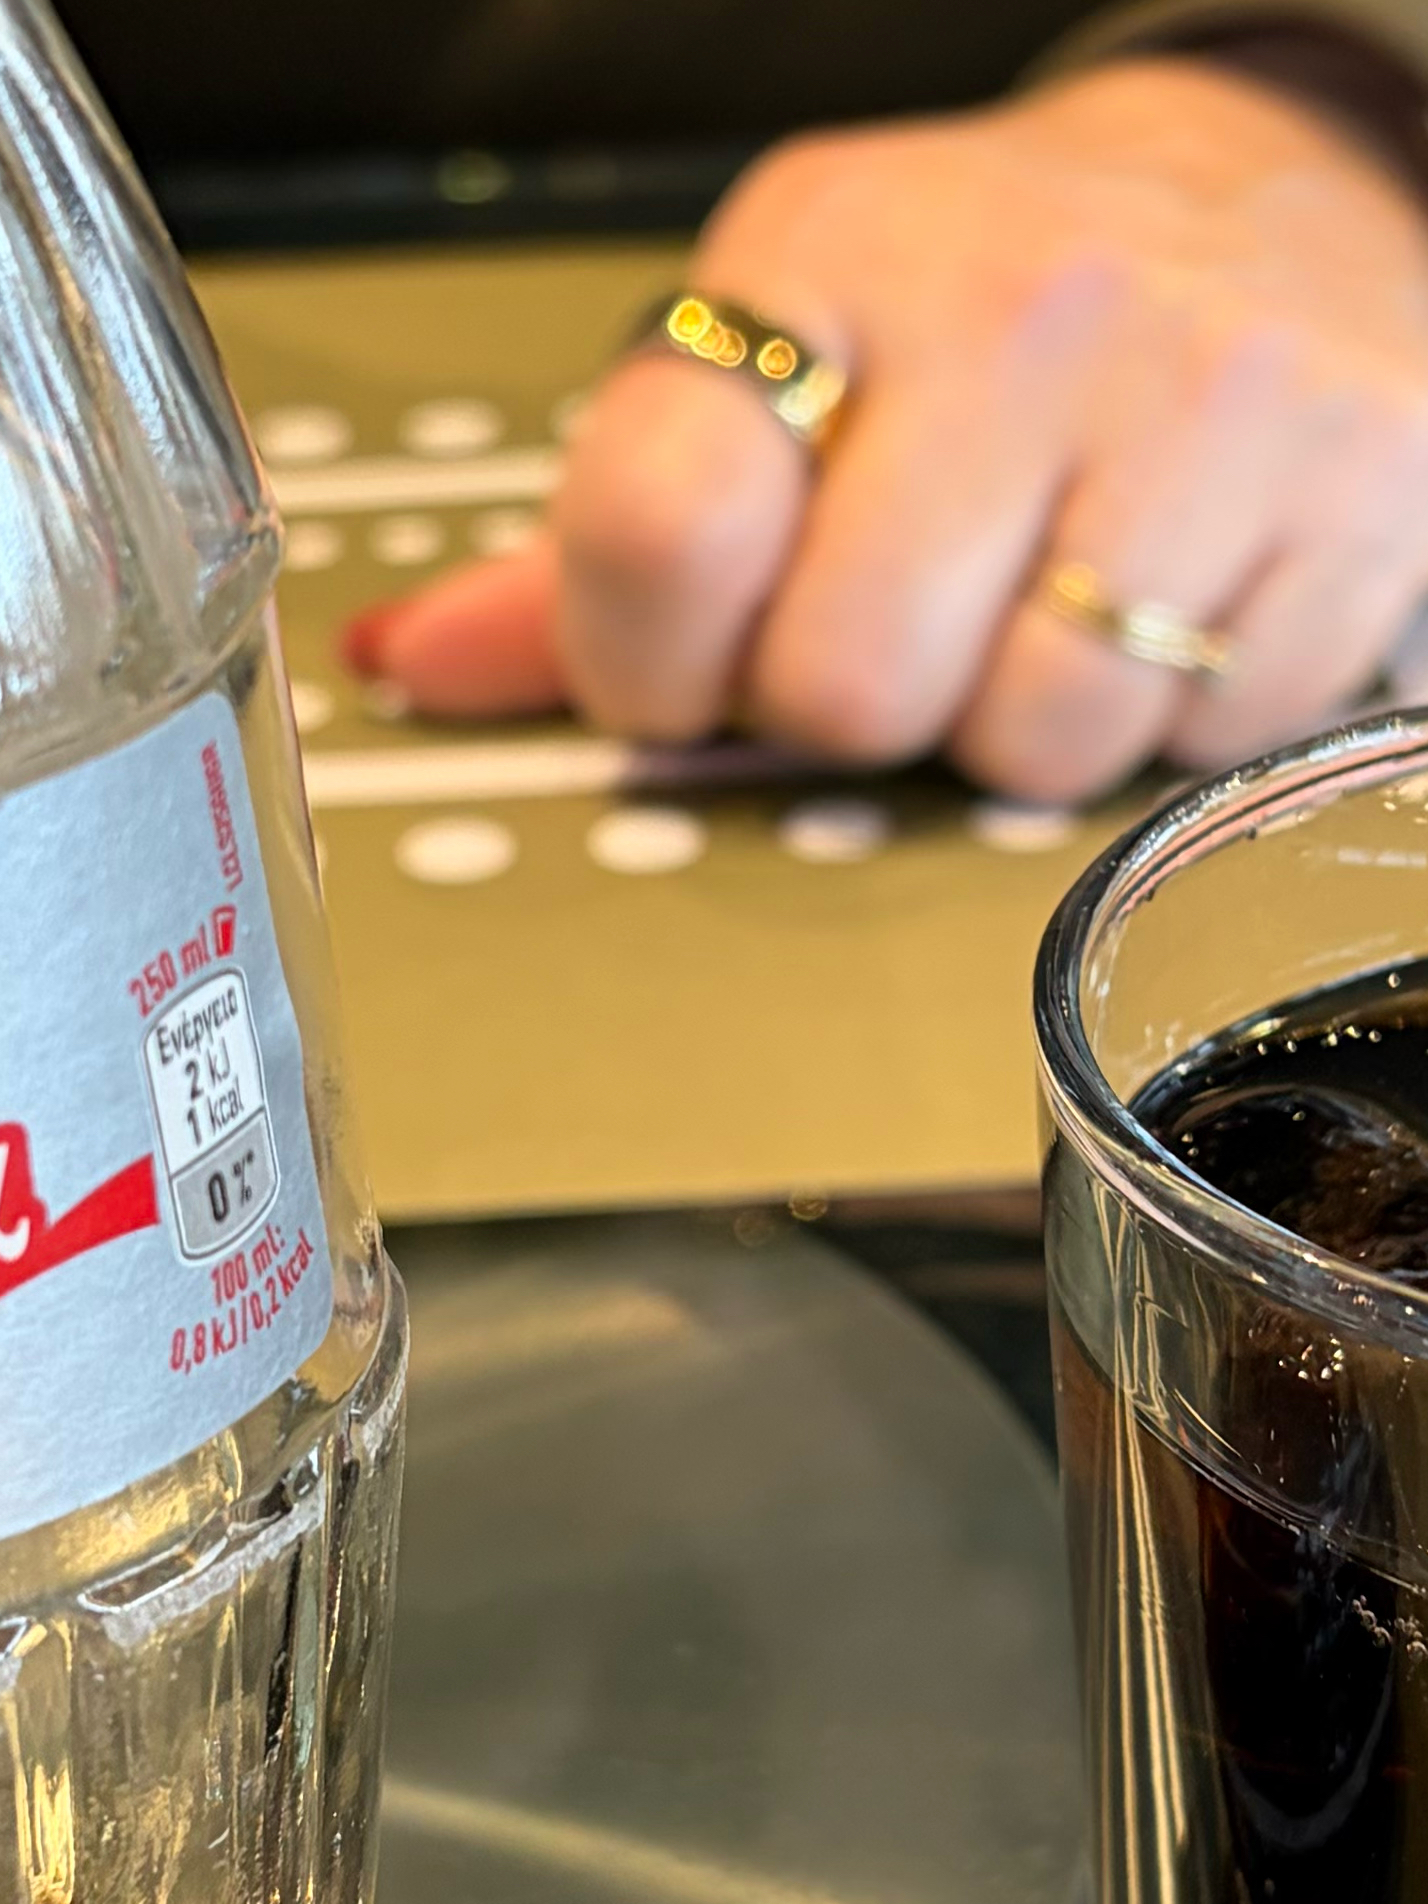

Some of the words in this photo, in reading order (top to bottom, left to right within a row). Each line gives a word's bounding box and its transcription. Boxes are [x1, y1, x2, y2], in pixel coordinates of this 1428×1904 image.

[128, 951, 178, 1018] 250
[180, 922, 211, 978] ml
[155, 986, 240, 1066] Ενέργεια
[184, 1060, 205, 1098] 2
[207, 1046, 232, 1084] kJ
[186, 1104, 204, 1148] 1
[209, 1082, 246, 1138] kcal
[206, 1170, 229, 1226] 0
[169, 1326, 208, 1376] 0,8
[279, 1226, 315, 1298] kcal
[210, 1250, 250, 1308] 100
